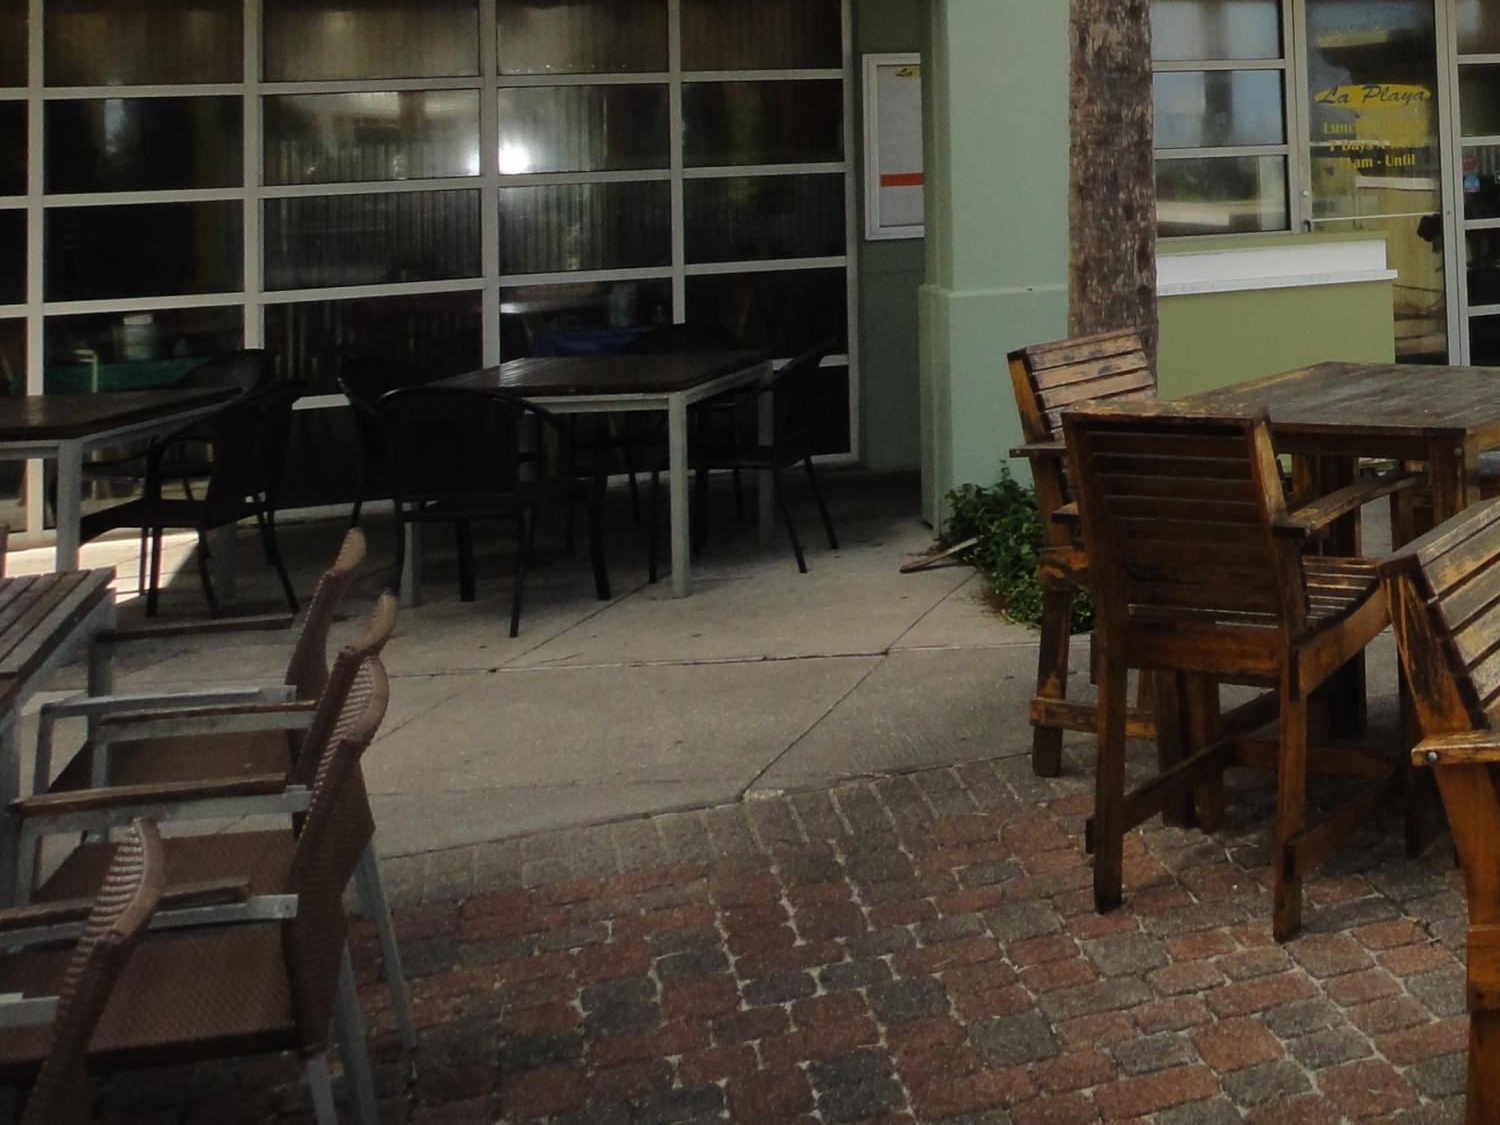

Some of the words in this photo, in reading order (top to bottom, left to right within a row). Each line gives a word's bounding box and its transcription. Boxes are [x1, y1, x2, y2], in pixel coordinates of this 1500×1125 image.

[1319, 86, 1350, 104] La
[1361, 83, 1425, 106] Playa
[1385, 154, 1416, 168] Until
